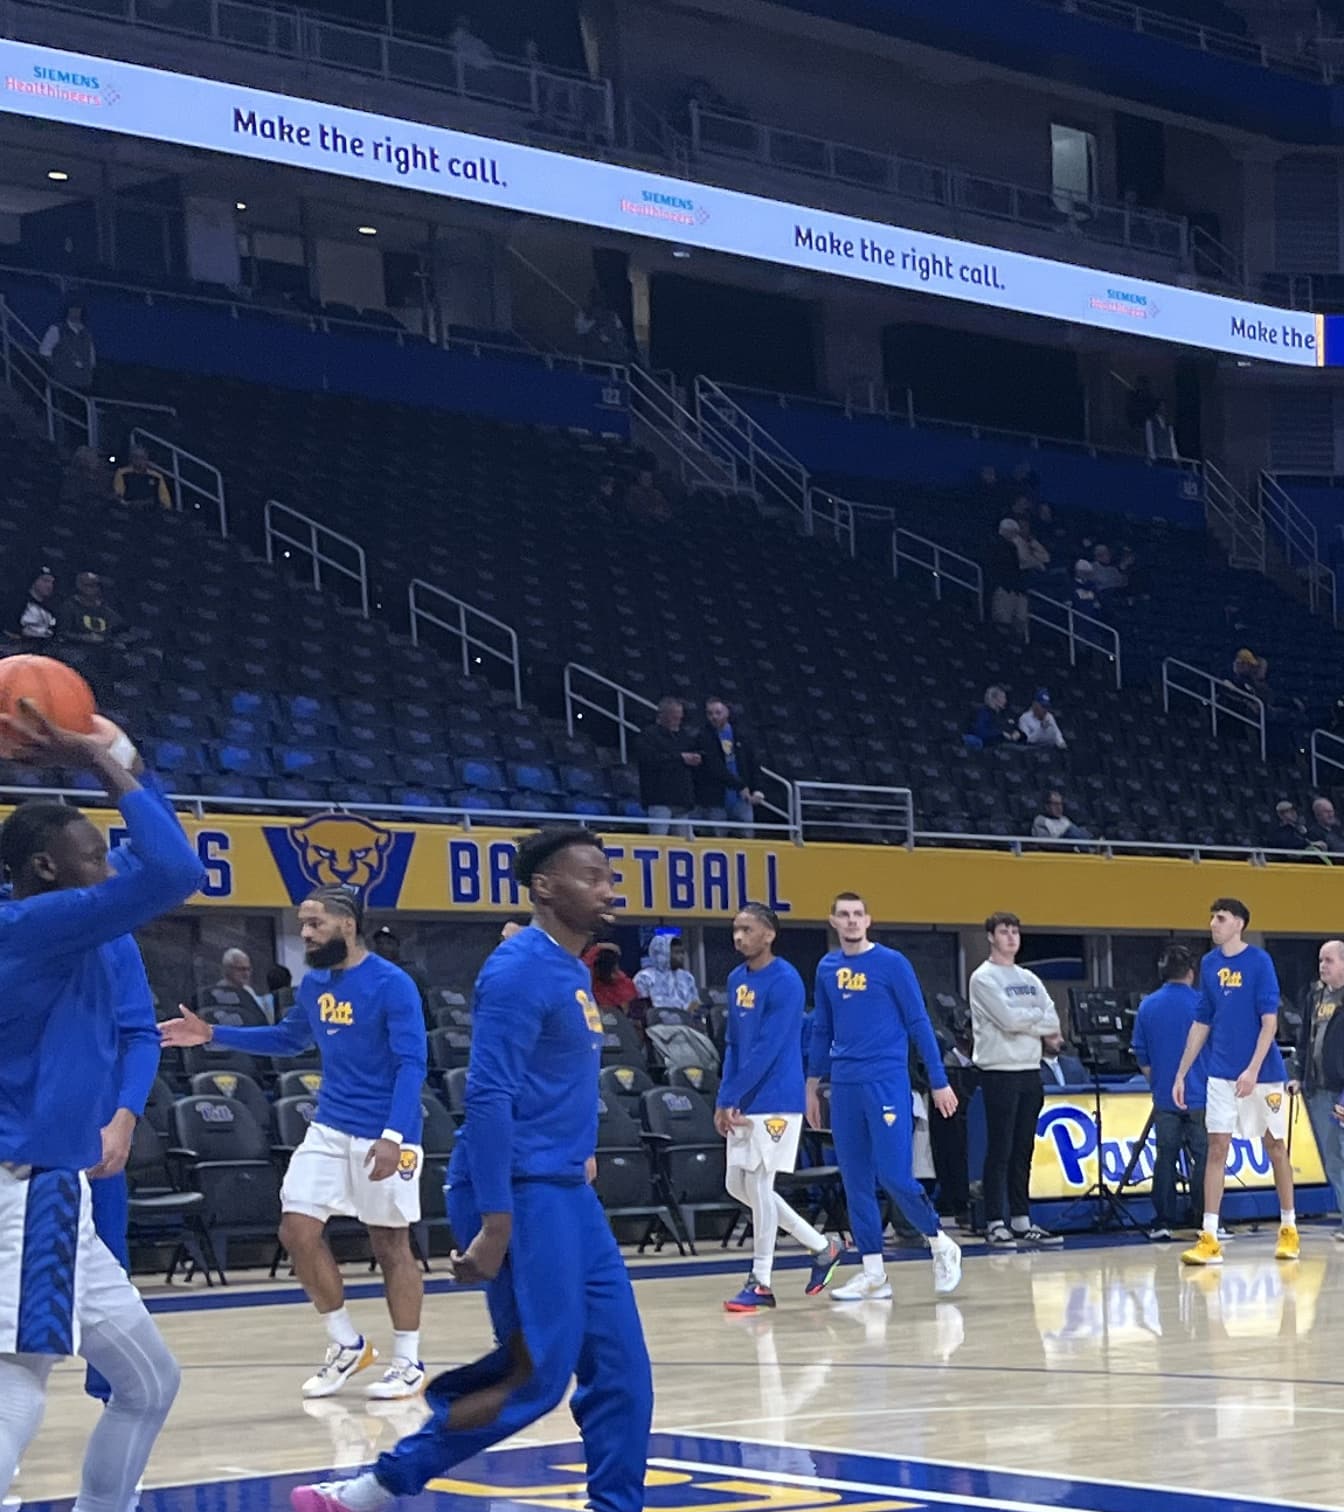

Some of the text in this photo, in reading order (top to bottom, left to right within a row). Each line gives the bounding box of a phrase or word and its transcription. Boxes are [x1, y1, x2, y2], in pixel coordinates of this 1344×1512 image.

[33, 65, 100, 90] SIEMENS
[233, 108, 508, 187] Make the right call.
[794, 224, 1006, 290] Make the right call.
[1231, 315, 1315, 350] Make the
[447, 838, 792, 913] BAETBALL
[835, 966, 868, 991] Pitt
[1217, 966, 1243, 988] Pitt
[317, 992, 355, 1026] Pitt
